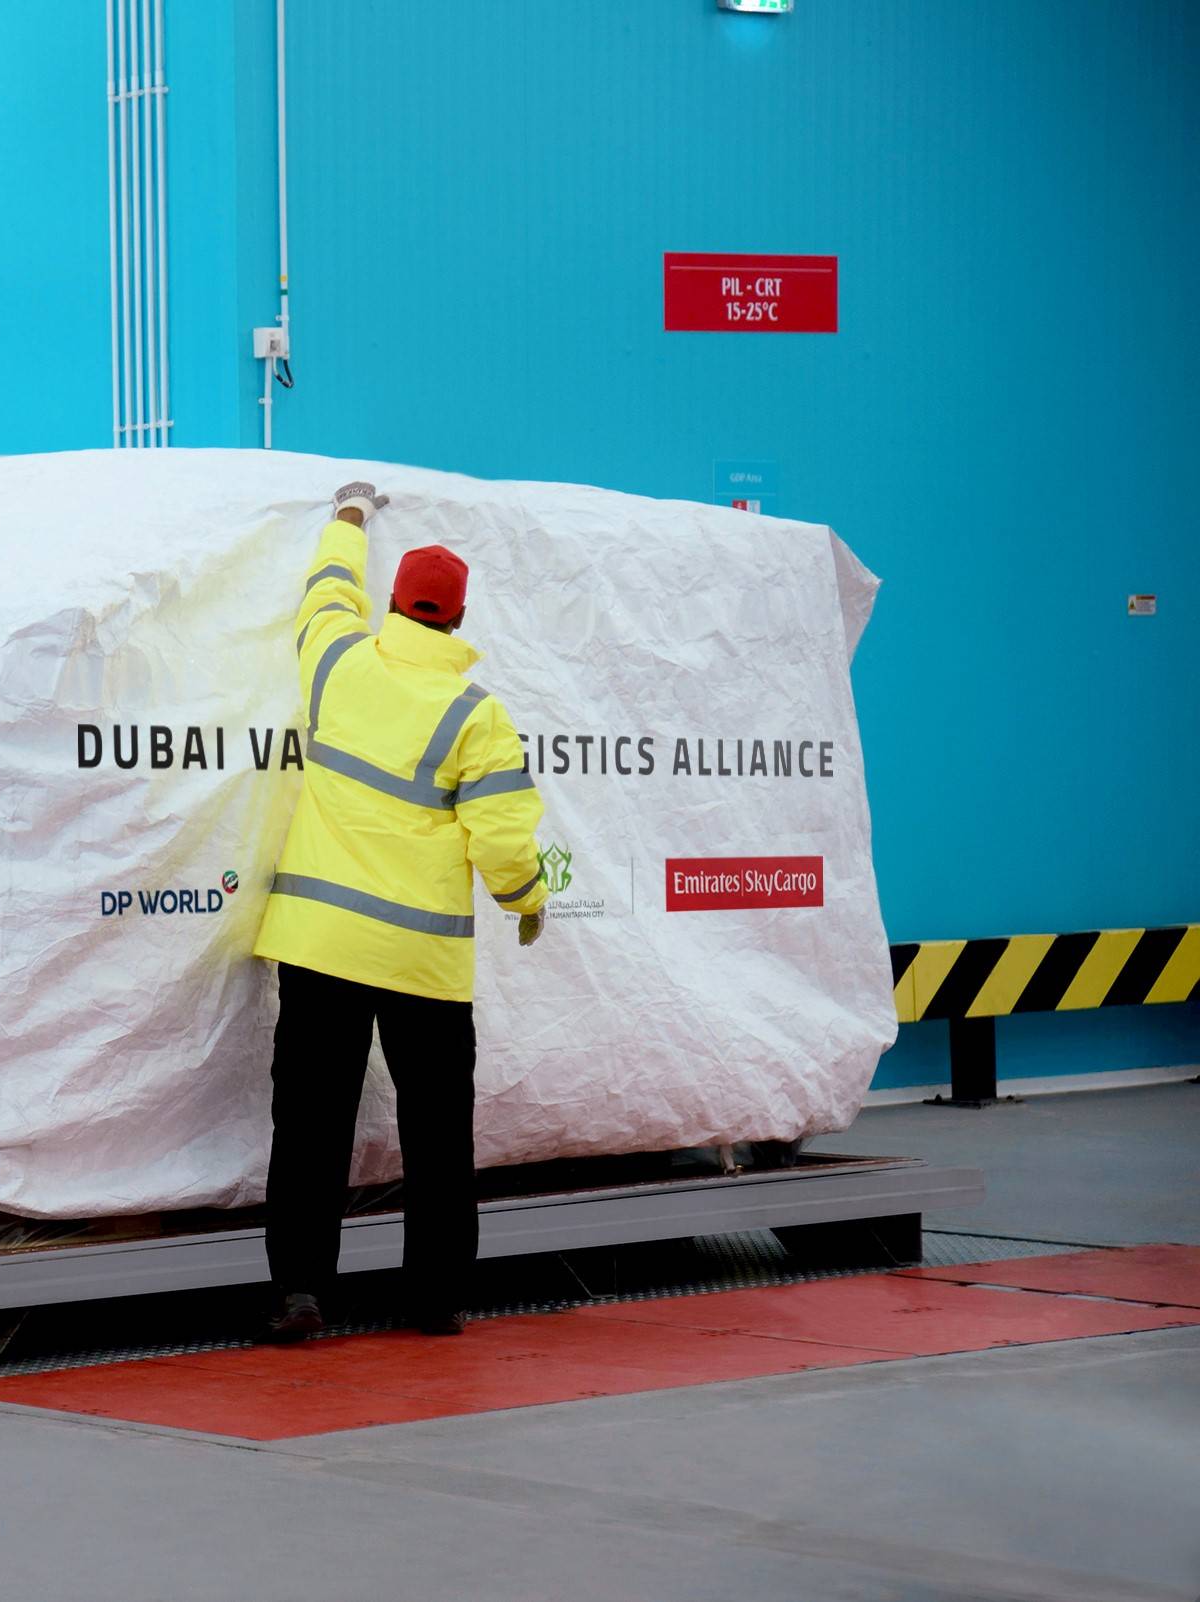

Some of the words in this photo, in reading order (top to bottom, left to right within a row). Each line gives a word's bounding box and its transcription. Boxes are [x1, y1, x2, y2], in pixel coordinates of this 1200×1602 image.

[721, 277, 744, 297] PIL
[755, 277, 783, 297] CRT
[77, 723, 225, 770] DUBAI
[672, 738, 835, 778] ALLIANCE
[673, 870, 741, 895] Emirates
[745, 869, 817, 897] SkyCargo
[101, 890, 133, 916] DP
[137, 888, 224, 915] WORLD
[549, 910, 591, 919] HUMANITARIAN
[591, 910, 605, 918] CITY
